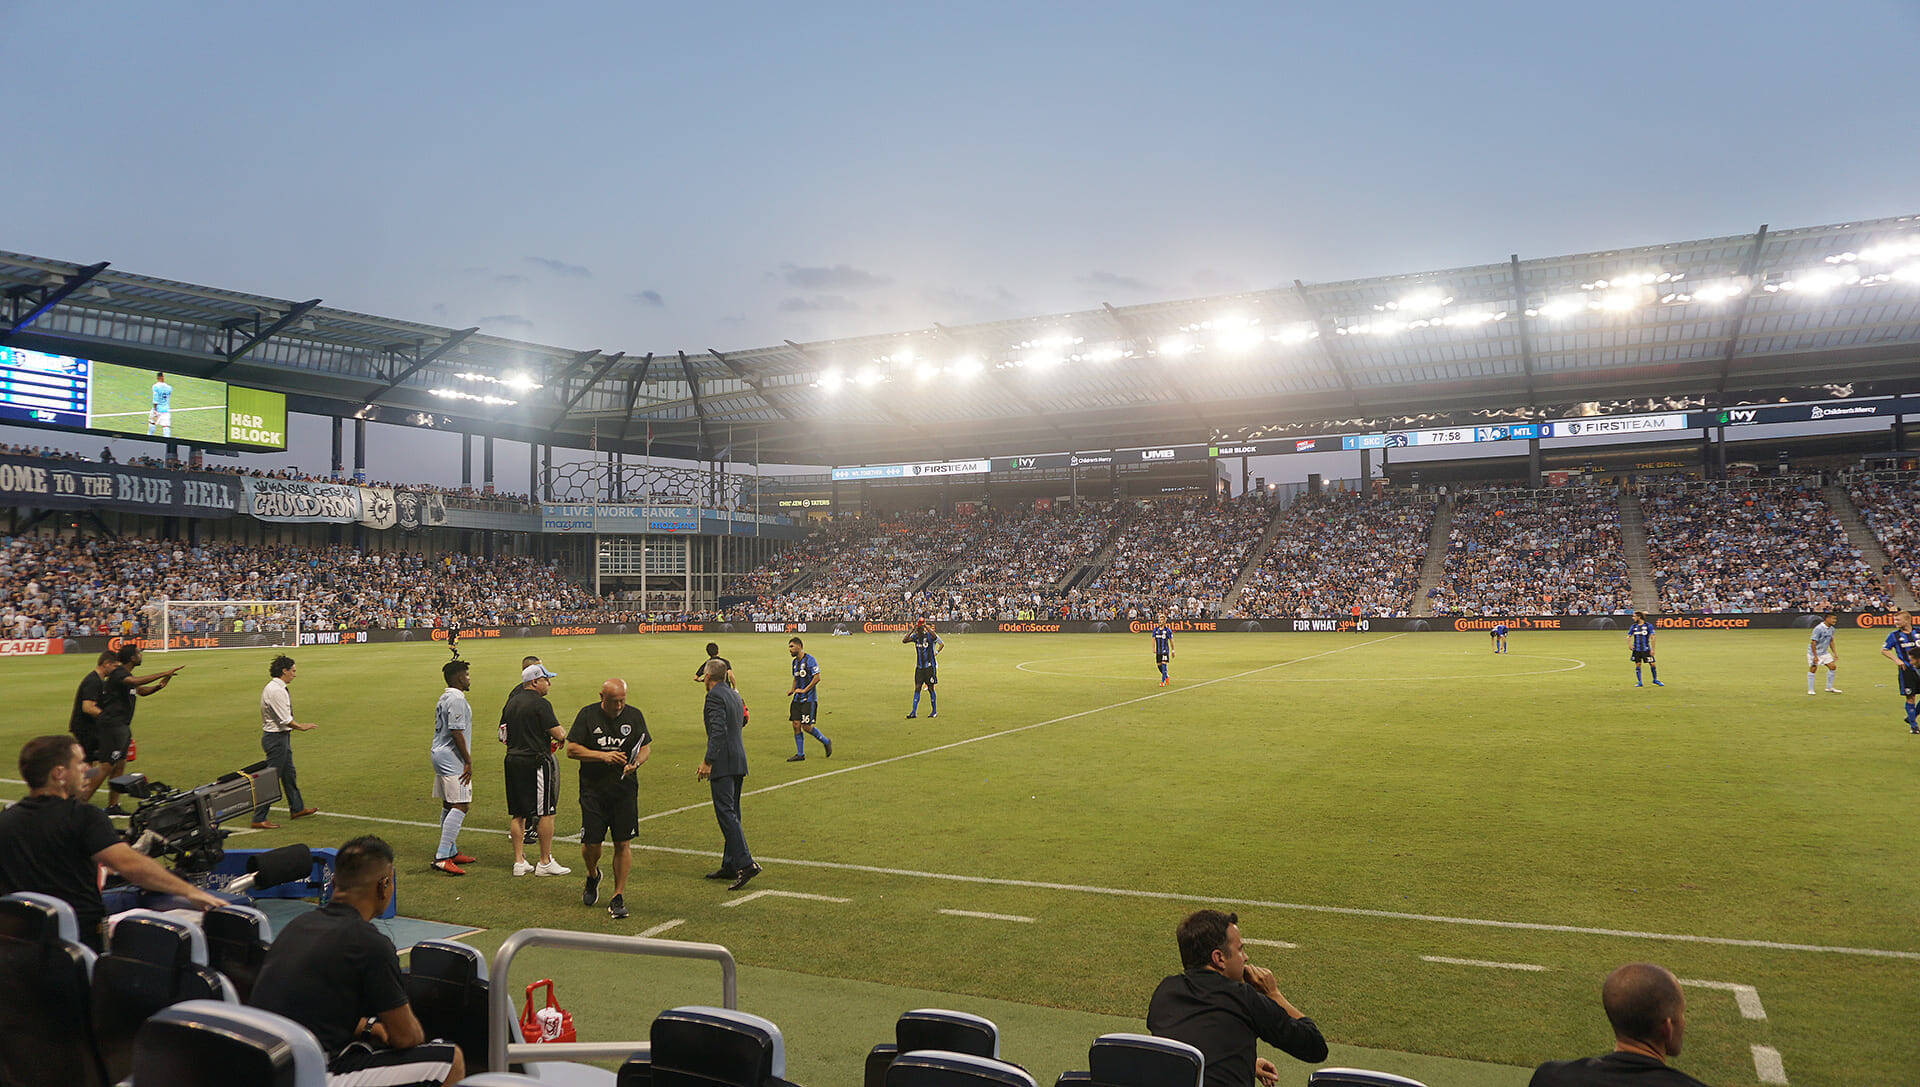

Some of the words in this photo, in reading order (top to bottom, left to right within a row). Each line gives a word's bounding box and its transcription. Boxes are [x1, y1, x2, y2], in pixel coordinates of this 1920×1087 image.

[231, 413, 263, 429] H&R
[231, 427, 280, 445] BLOCK
[1513, 428, 1532, 437] MTL
[1542, 426, 1549, 436] 0
[1363, 437, 1380, 446] SKC
[1431, 432, 1461, 442] 77:58
[1348, 439, 1355, 447] 1
[1142, 450, 1175, 459] UMB
[0, 463, 48, 493] OME
[53, 473, 76, 494] TO
[81, 476, 112, 496] THE
[117, 473, 172, 505] BLUE
[183, 480, 235, 509] HELL
[254, 491, 357, 519] CAULDRON
[562, 506, 593, 517] LIVE.
[597, 507, 638, 517] WORK.
[545, 520, 593, 529] mazuma
[755, 623, 766, 633] FOR
[768, 623, 785, 633] WHAT
[798, 623, 807, 632] DO
[863, 621, 908, 633] Continental
[998, 623, 1060, 632] #OdeToSoccer
[1194, 622, 1217, 631] TIRE
[1293, 620, 1310, 631] FOR
[1312, 620, 1337, 631] WHAT
[1533, 619, 1561, 628] TIRE
[1655, 617, 1750, 629] #OdeToSoccer
[300, 632, 316, 645] FOR
[317, 631, 340, 644] WHAT
[356, 631, 367, 642] DO
[483, 629, 500, 637] TIRE
[193, 638, 219, 648] TIRE
